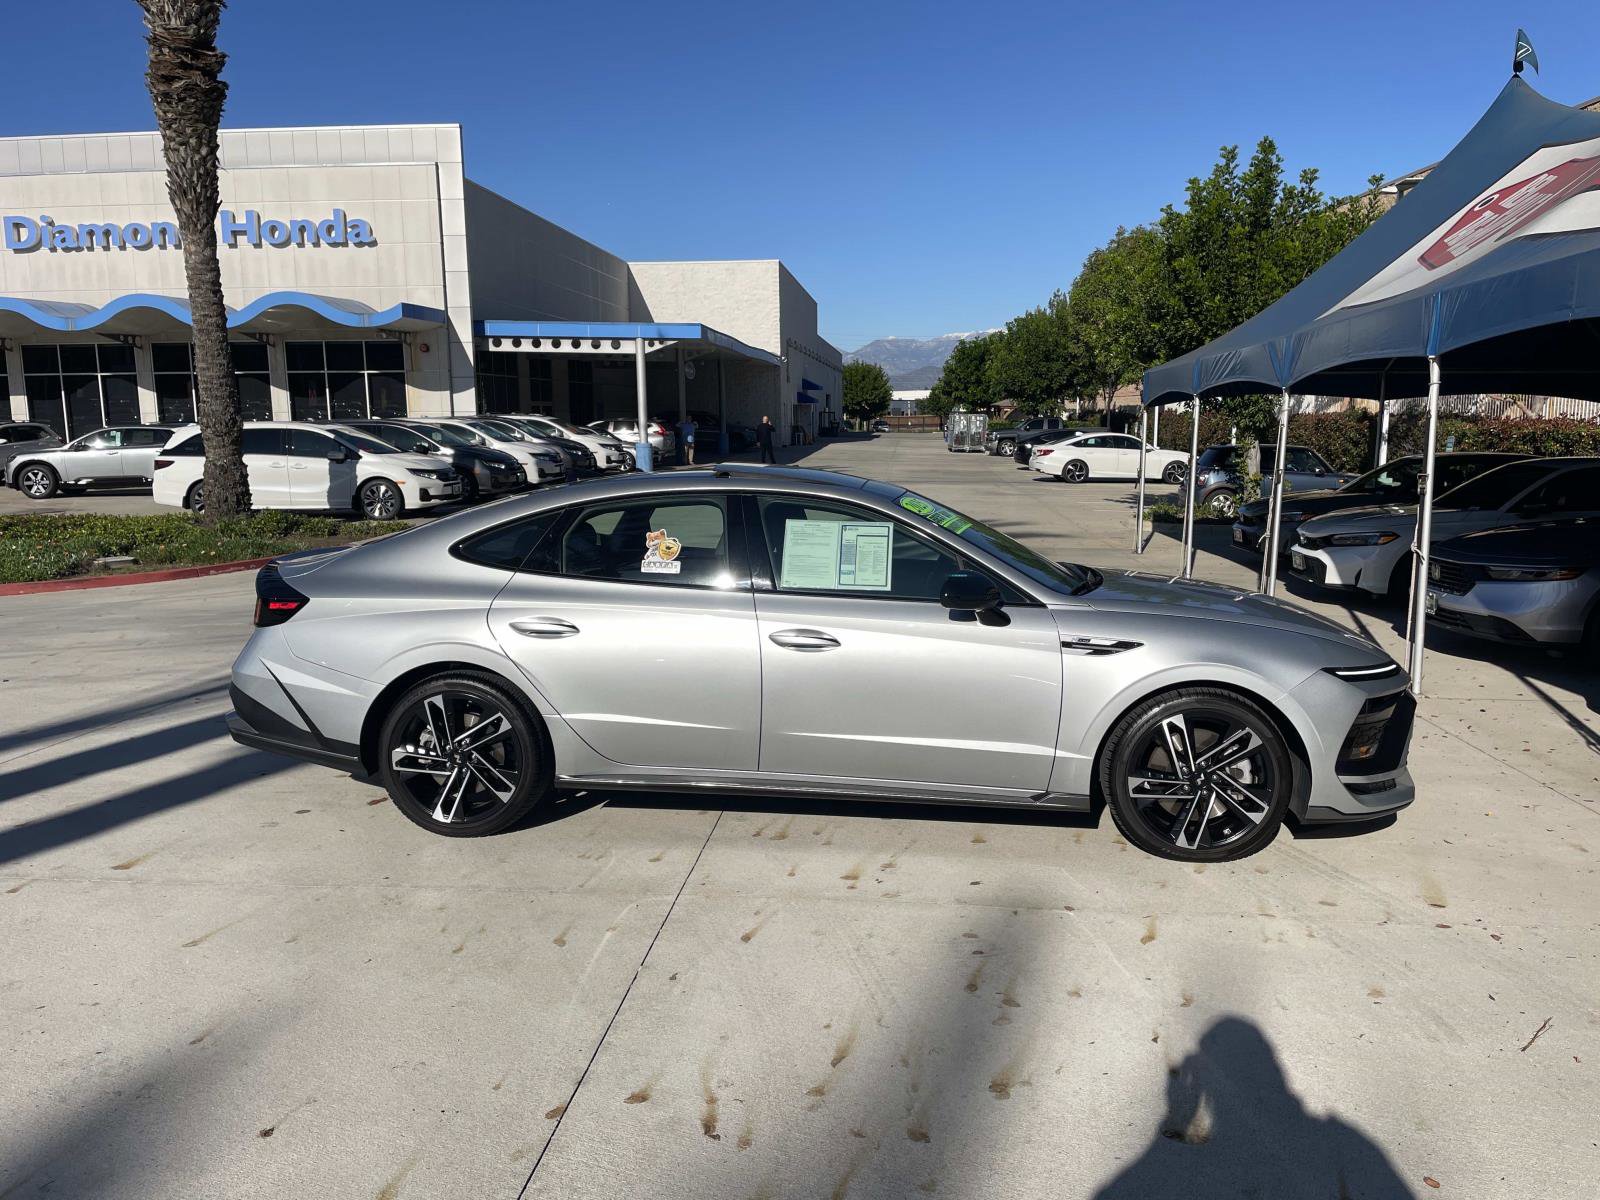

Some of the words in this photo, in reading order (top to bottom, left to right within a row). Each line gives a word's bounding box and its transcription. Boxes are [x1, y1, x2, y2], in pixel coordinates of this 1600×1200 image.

[3, 214, 182, 252] Diamon
[220, 208, 377, 247] Honda
[642, 561, 678, 569] CARFA
